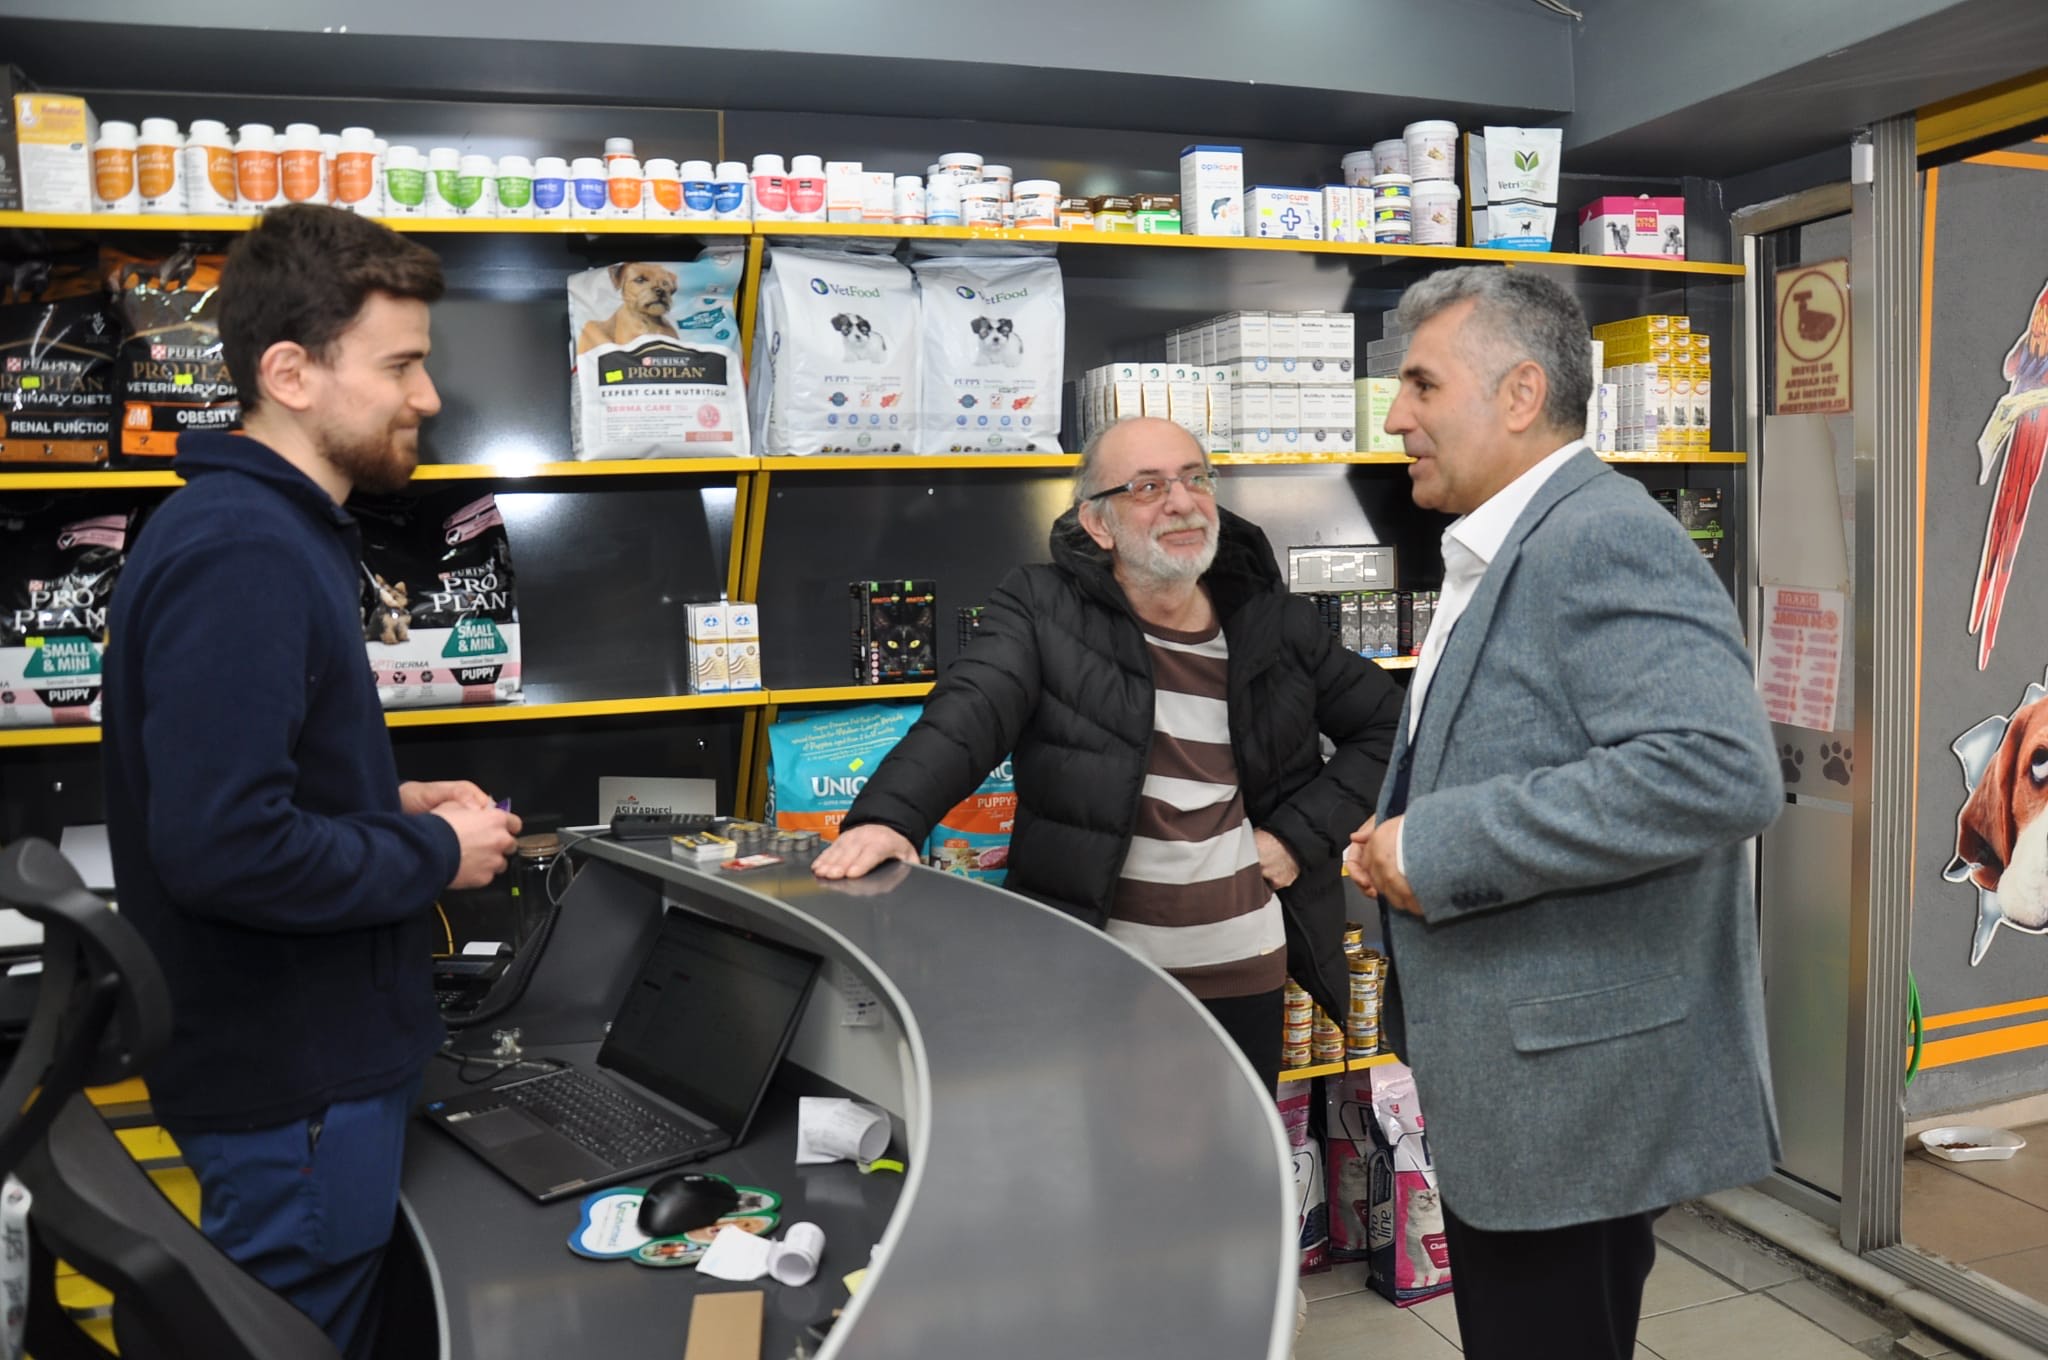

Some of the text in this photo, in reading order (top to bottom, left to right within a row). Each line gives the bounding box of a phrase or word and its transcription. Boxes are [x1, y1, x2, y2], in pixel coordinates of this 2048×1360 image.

[829, 284, 881, 298] VetFood
[979, 288, 1029, 305] VetFood
[133, 361, 233, 382] PRO PLA
[628, 367, 704, 378] PRO PLAN
[127, 382, 217, 397] VETERINARY
[601, 390, 639, 398] EXPERT
[675, 389, 727, 397] NUTRITION
[72, 394, 112, 404] DIETS
[176, 409, 237, 424] OBESITY
[11, 421, 51, 433] RENAL
[442, 573, 498, 594] PRO
[30, 588, 95, 611] PRO
[429, 591, 510, 613] PLAN
[13, 608, 107, 632] PLAN
[457, 624, 494, 638] SMALL
[42, 643, 89, 658] SMALL
[458, 638, 495, 652] & MINI
[43, 656, 90, 673] & MINI
[461, 667, 495, 680] PUPPY
[48, 688, 90, 702] PUPPY
[810, 776, 869, 798] UNIC
[977, 796, 1012, 809] PUPPY
[1378, 1209, 1392, 1243] line
